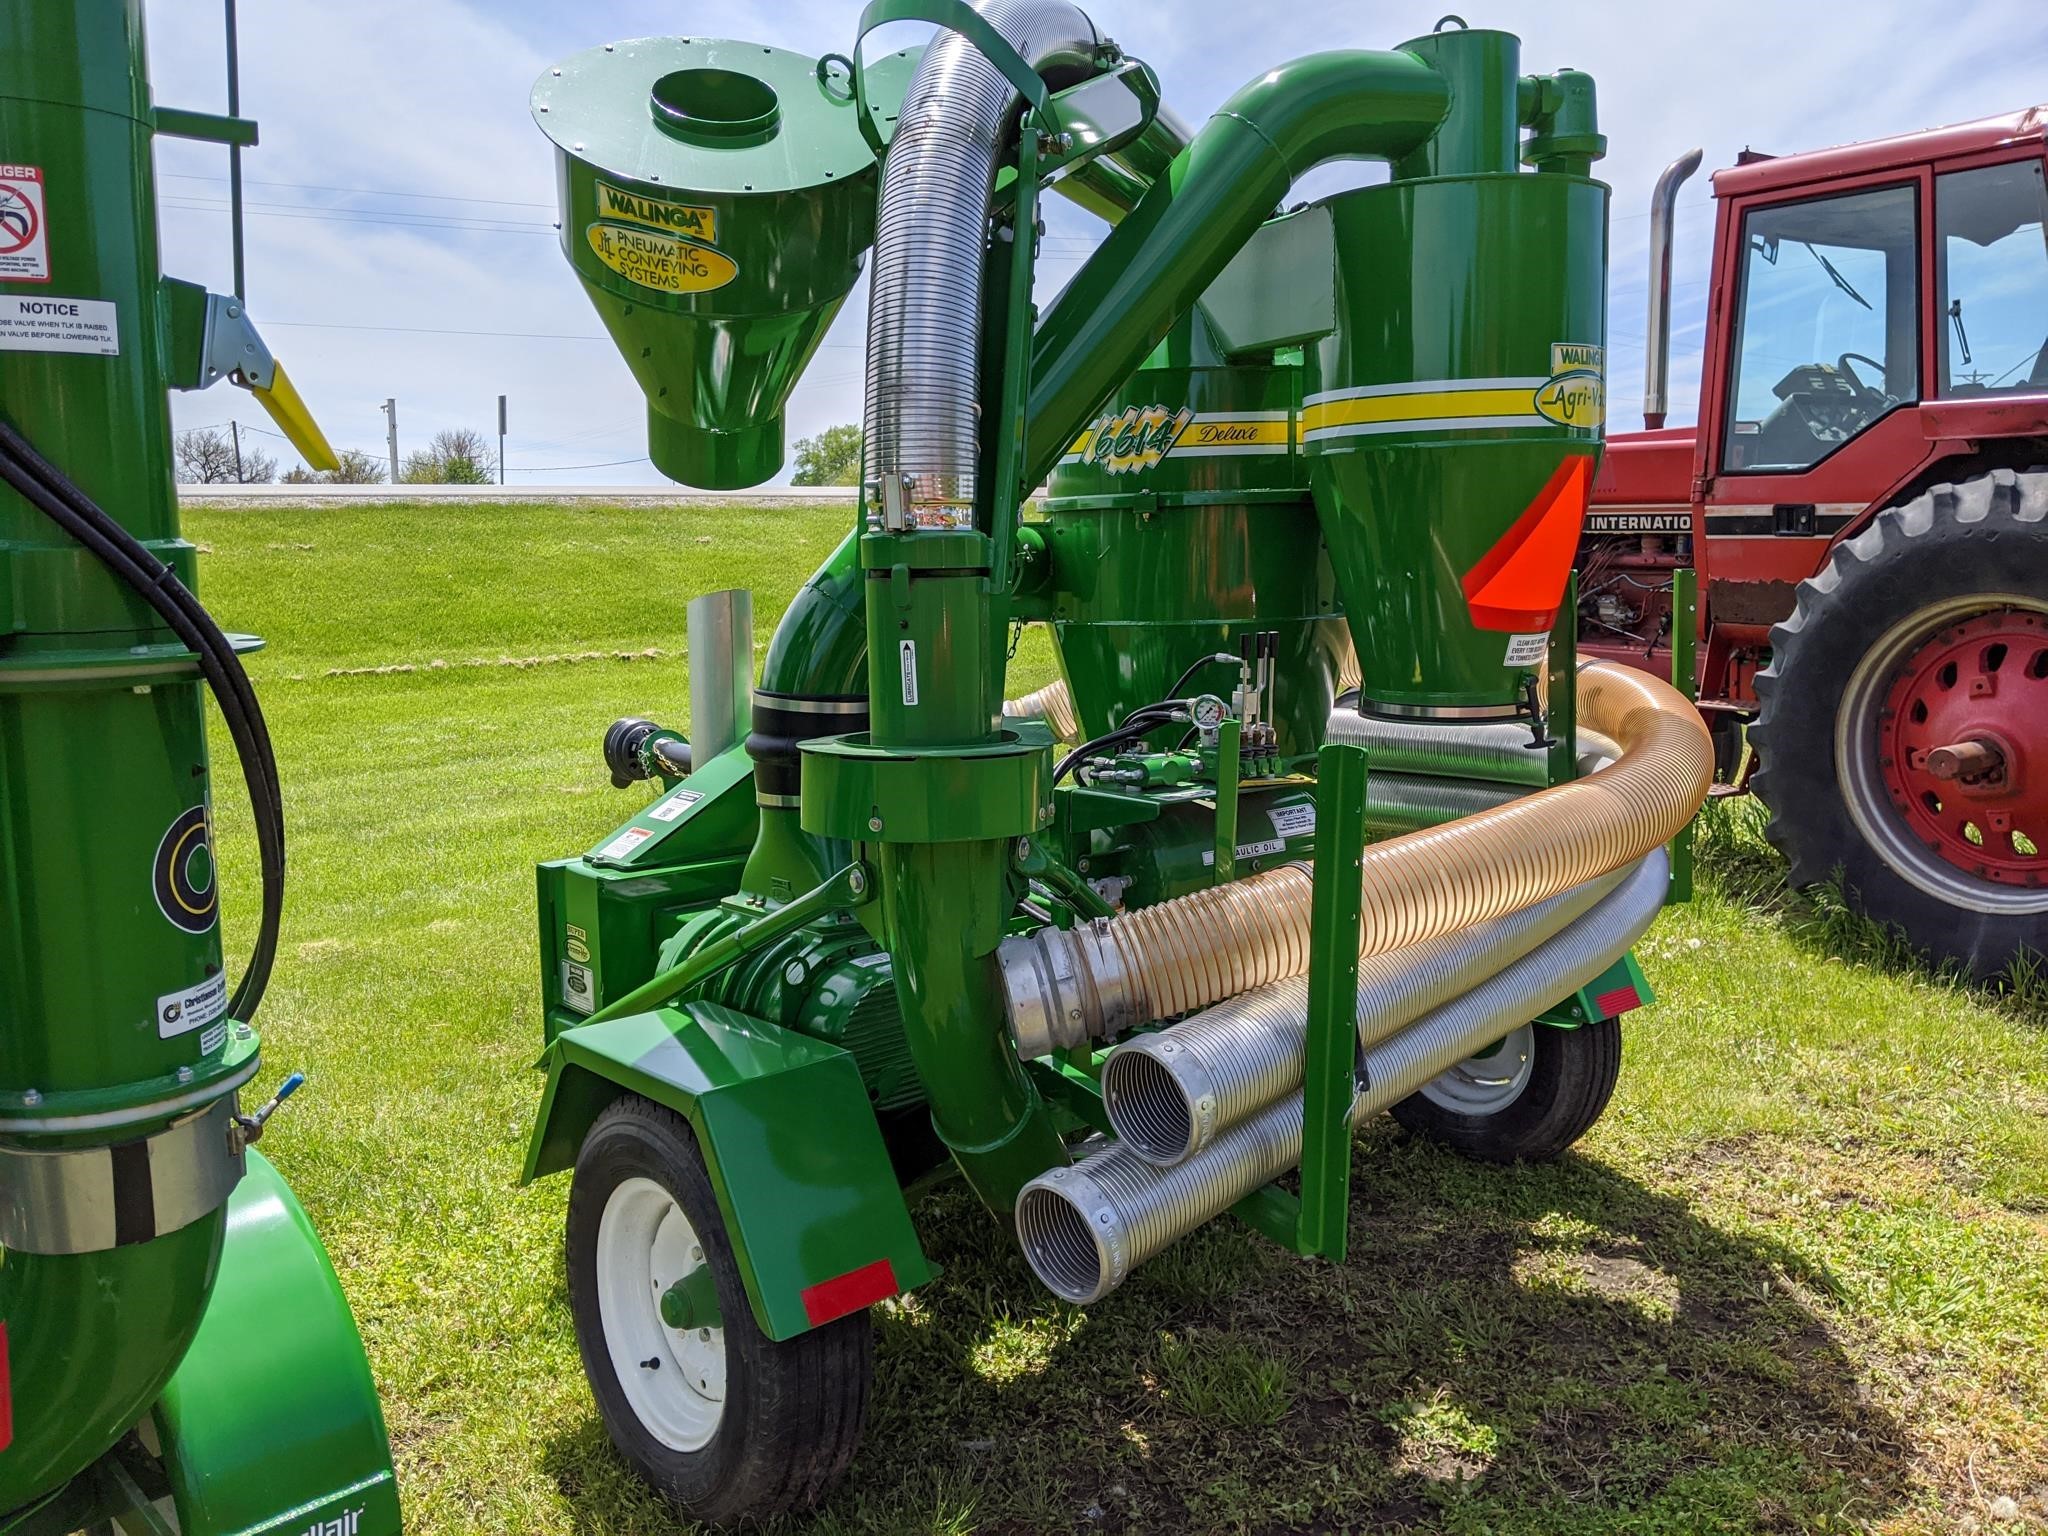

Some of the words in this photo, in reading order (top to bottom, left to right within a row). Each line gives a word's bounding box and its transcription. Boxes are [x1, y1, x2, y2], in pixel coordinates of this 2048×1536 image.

[0, 166, 36, 179] GER
[606, 190, 703, 229] WALINGA
[617, 231, 699, 261] PNEUMATIC
[618, 248, 708, 277] CONVEYING
[620, 262, 680, 288] SYSTEMS
[20, 302, 79, 316] NOTICE
[1561, 348, 1603, 366] WALING
[1096, 418, 1175, 457] 6614
[1198, 425, 1258, 441] Deluxe
[1591, 515, 1691, 530] INTERNATIO
[1275, 807, 1308, 817] IMPORTANT
[1263, 843, 1277, 853] OIL
